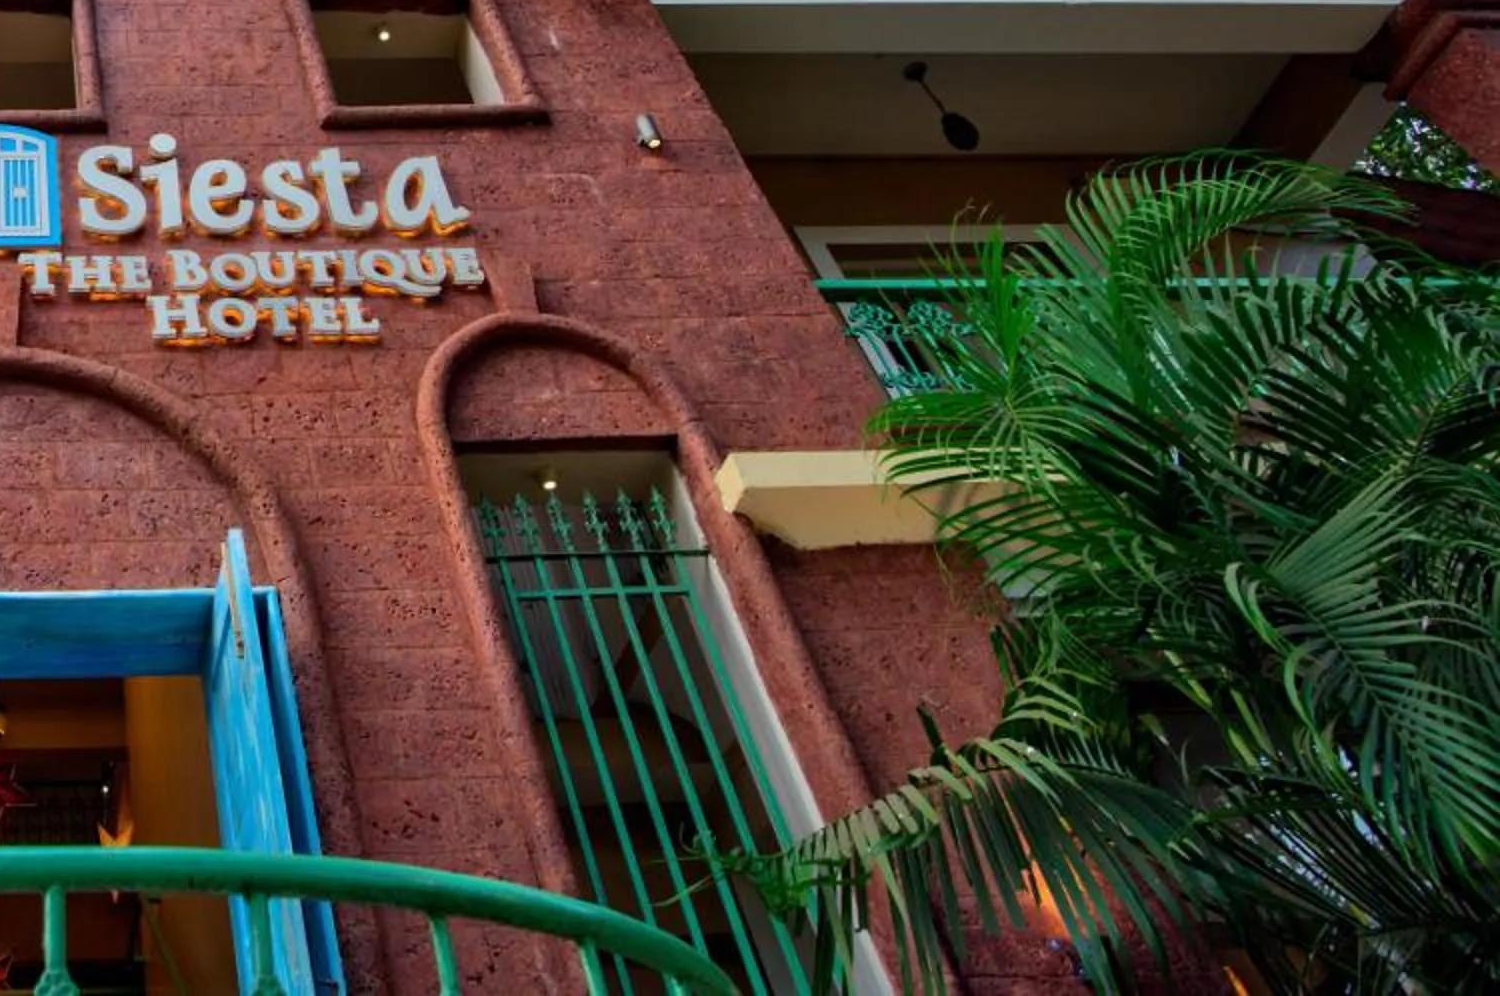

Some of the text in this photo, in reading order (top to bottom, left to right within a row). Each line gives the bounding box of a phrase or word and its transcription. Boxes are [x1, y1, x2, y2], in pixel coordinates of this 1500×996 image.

[77, 133, 471, 236] Siesta
[17, 247, 485, 297] THE BOUTIQUE
[147, 295, 381, 340] HOTEL
